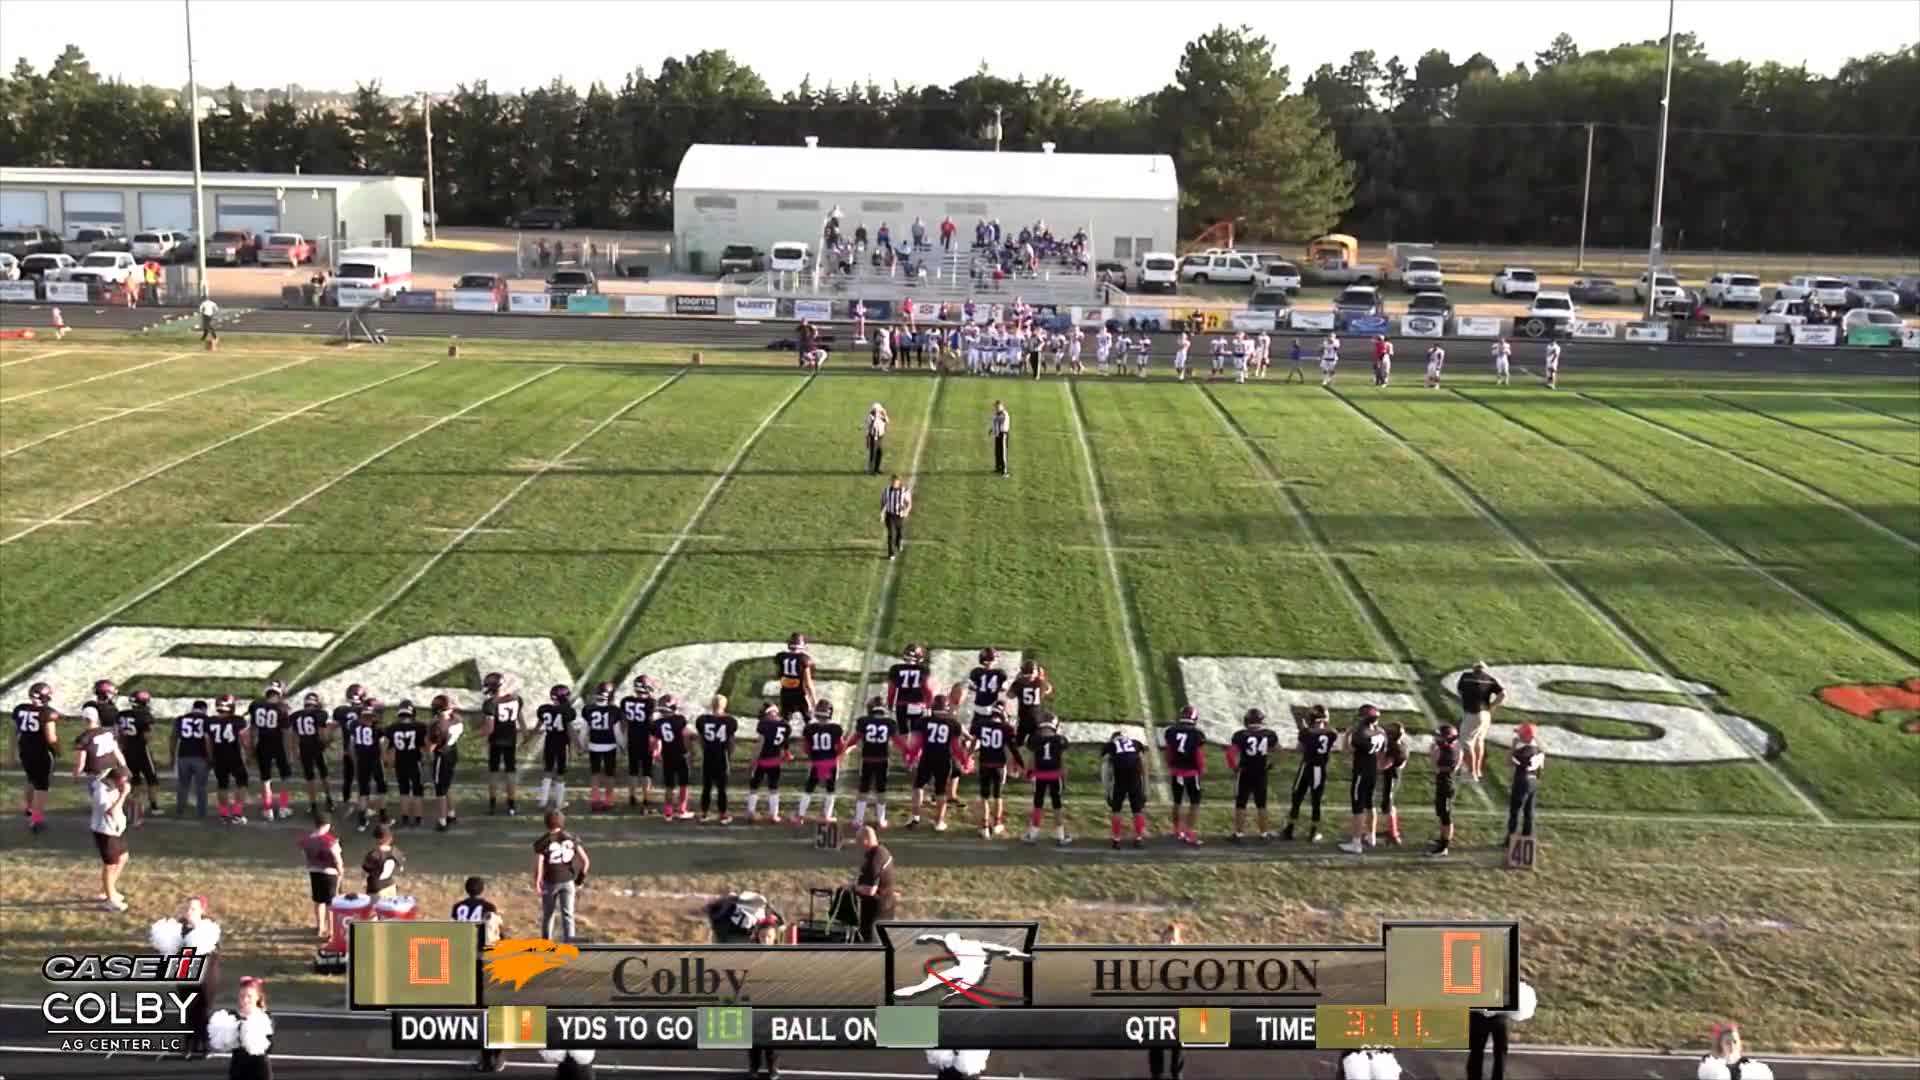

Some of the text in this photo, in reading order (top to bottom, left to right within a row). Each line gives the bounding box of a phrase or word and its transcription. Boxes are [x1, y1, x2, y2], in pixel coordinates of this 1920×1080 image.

[783, 658, 798, 677] 11
[899, 669, 921, 689] 77
[980, 674, 999, 693] 14
[1022, 687, 1041, 706] 51
[18, 710, 40, 733] 75
[255, 707, 278, 729] 60
[542, 712, 565, 732] 24
[590, 711, 610, 730] 21
[624, 701, 646, 723] 55
[181, 717, 205, 739] 53
[209, 723, 235, 743] 74
[296, 716, 316, 736] 16
[355, 725, 373, 746] 18
[661, 722, 674, 743] 6
[703, 725, 727, 743] 54
[773, 727, 786, 745] 5
[865, 724, 889, 743] 23
[926, 722, 950, 744] 79
[393, 729, 417, 751] 67
[811, 732, 832, 751] 10
[980, 726, 1004, 749] 50
[1176, 733, 1187, 753] 7
[1245, 736, 1269, 756] 34
[1317, 735, 1329, 754] 3
[1042, 741, 1052, 761] 1
[817, 823, 840, 848] 50
[1511, 838, 1535, 866] 40
[456, 904, 483, 920] 84
